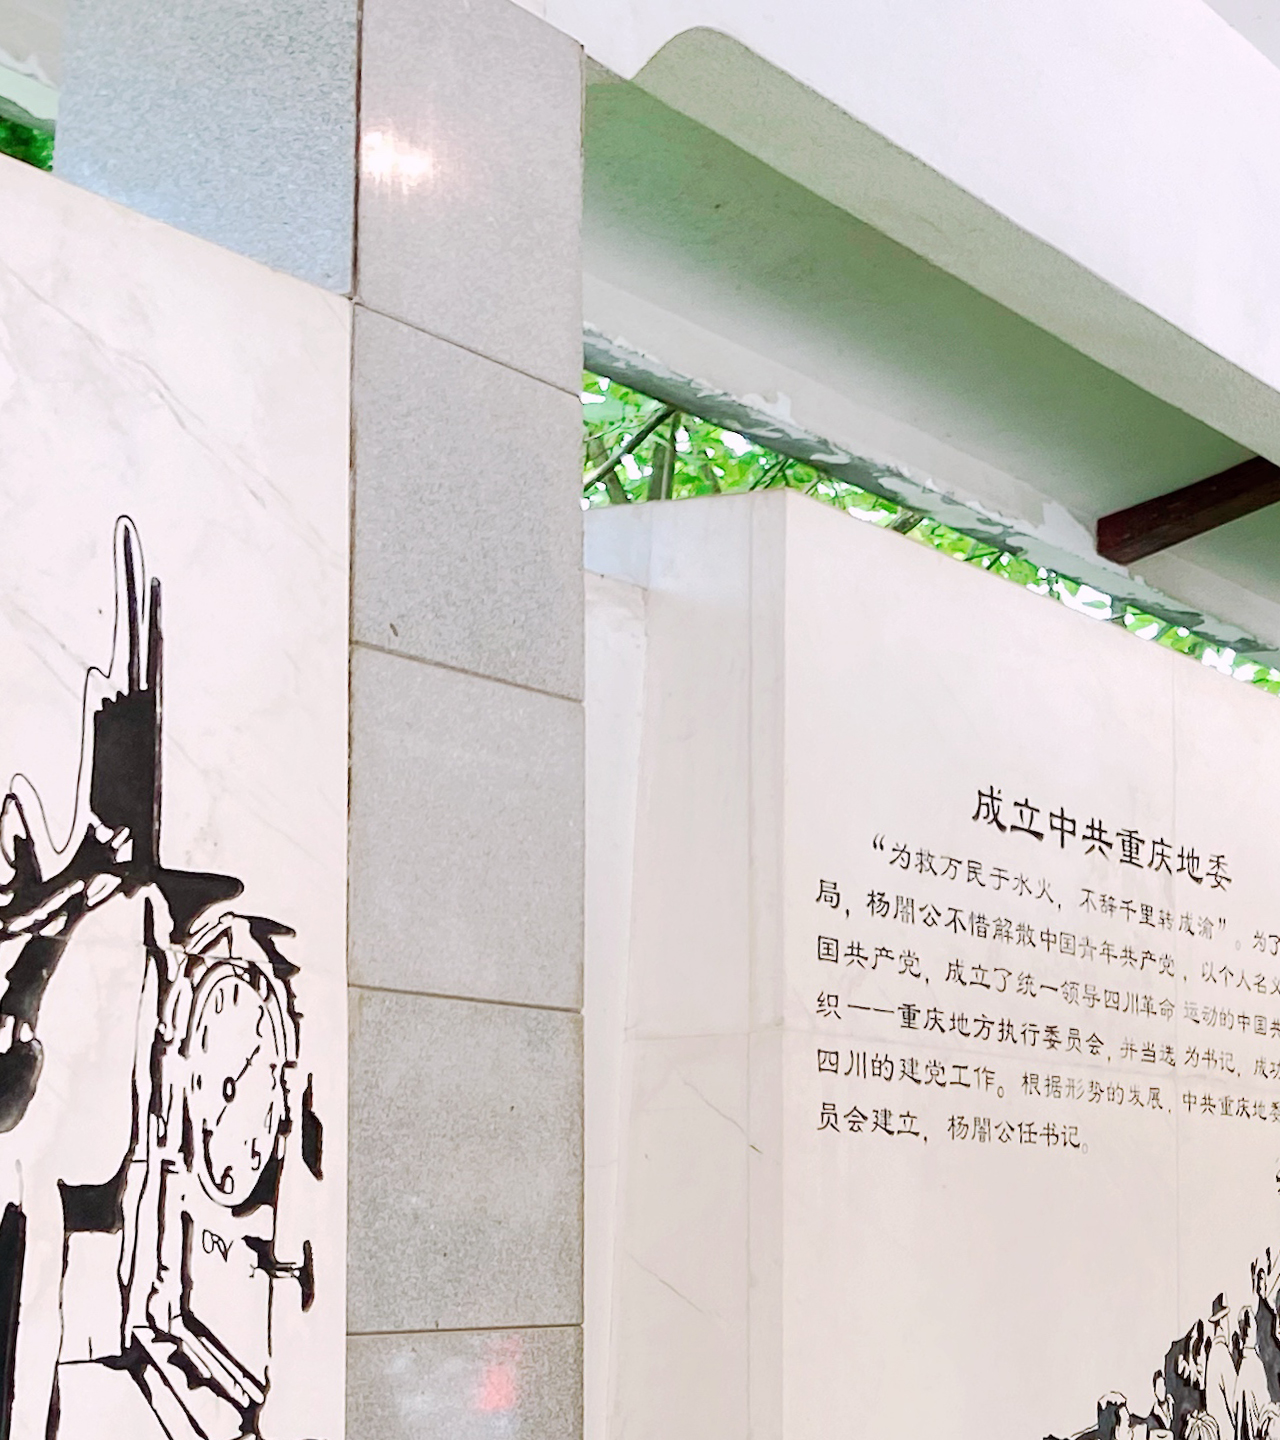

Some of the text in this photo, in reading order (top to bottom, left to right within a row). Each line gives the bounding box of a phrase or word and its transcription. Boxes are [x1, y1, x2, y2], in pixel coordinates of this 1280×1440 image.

[972, 785, 1233, 891] 成立中共重庆地委
